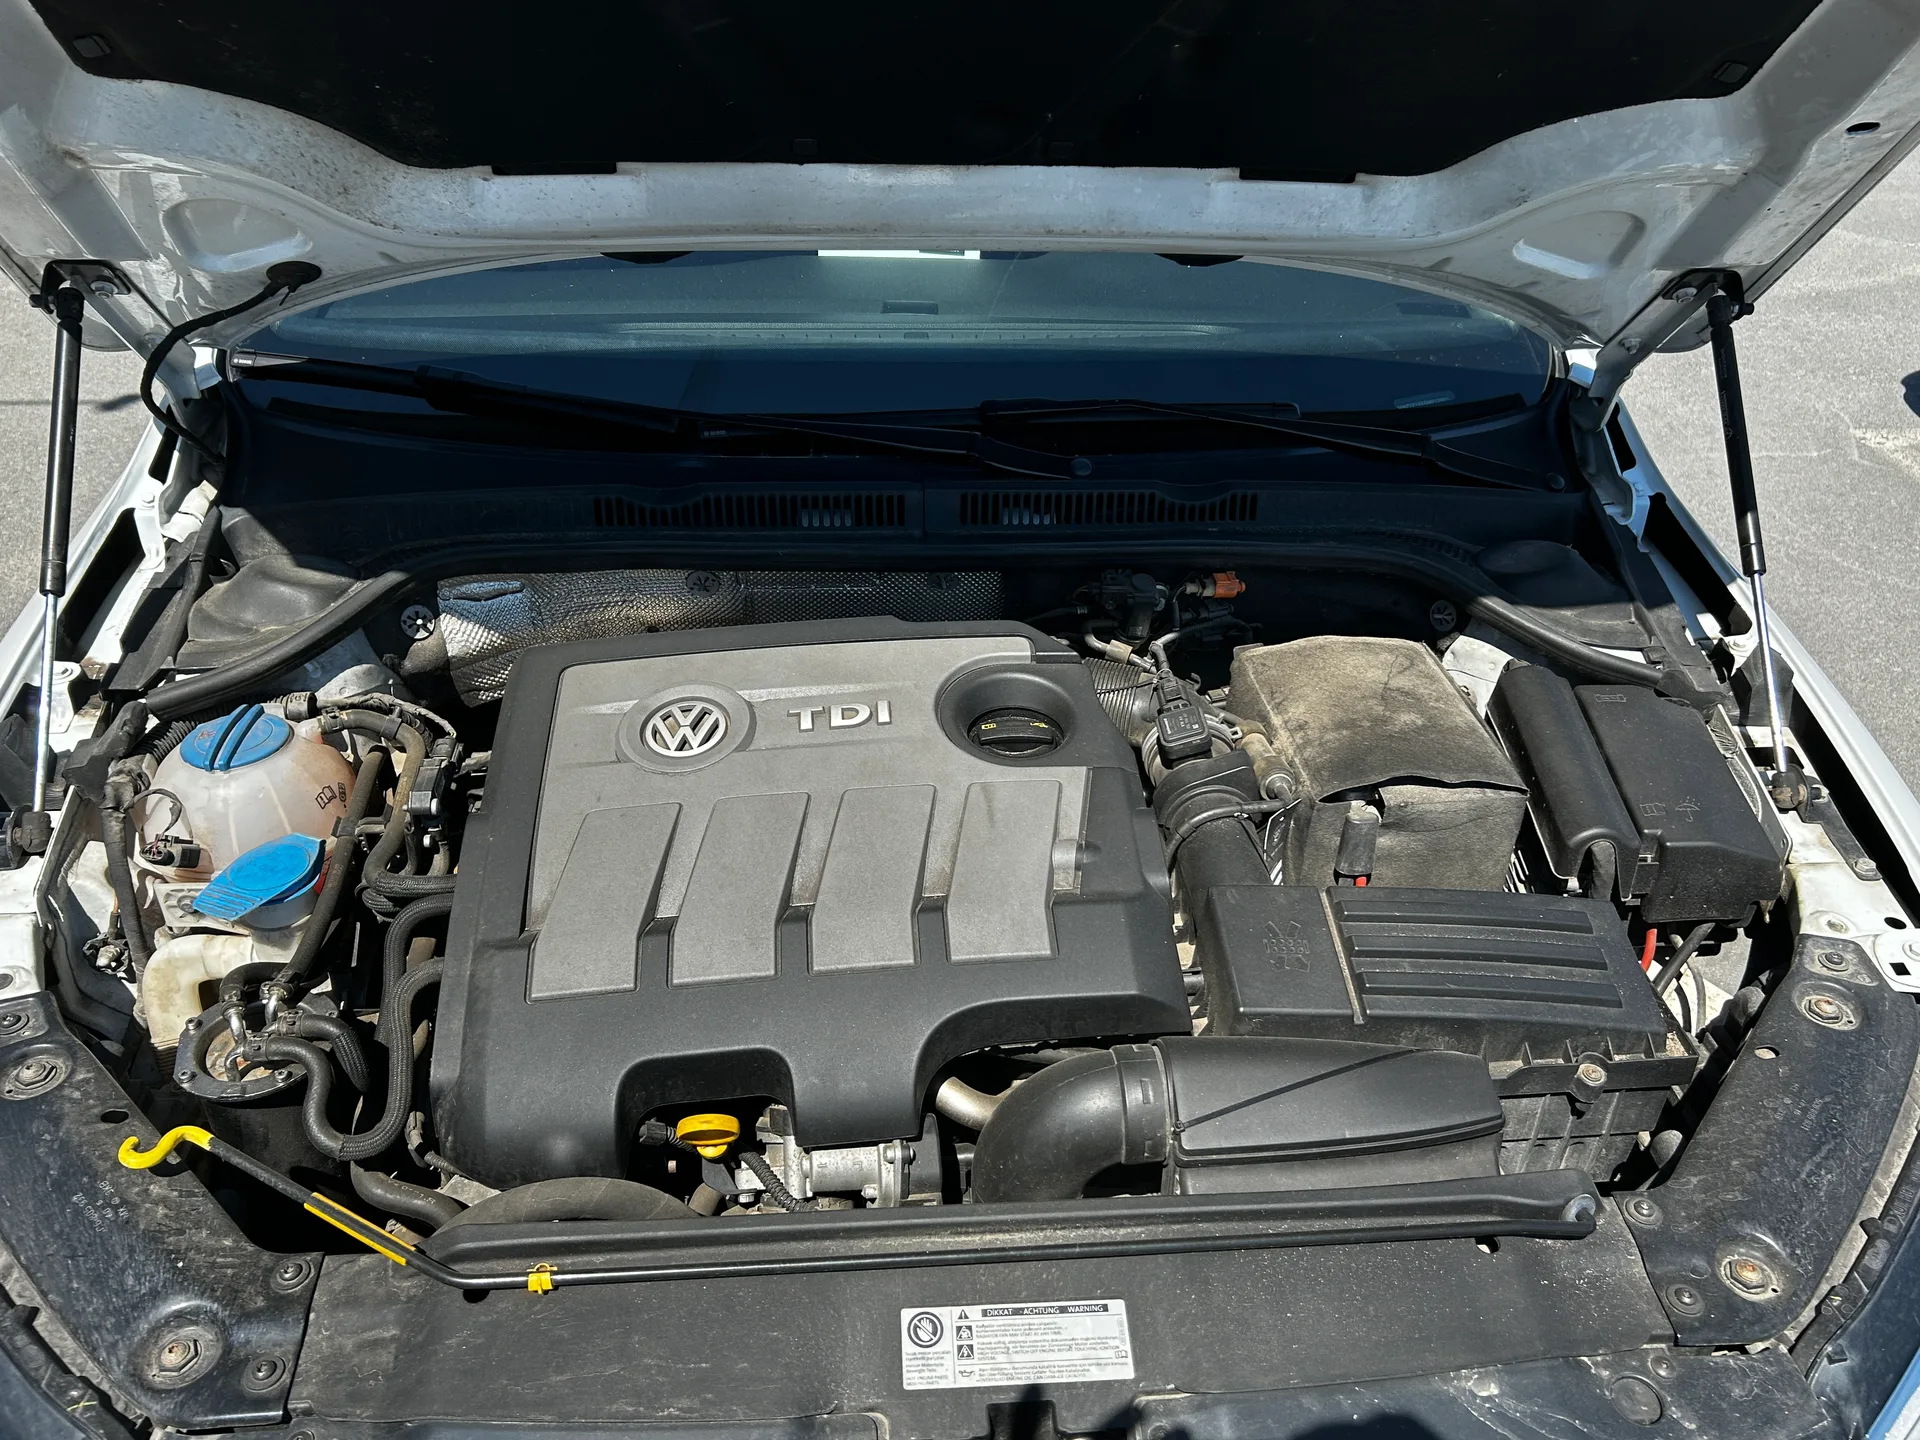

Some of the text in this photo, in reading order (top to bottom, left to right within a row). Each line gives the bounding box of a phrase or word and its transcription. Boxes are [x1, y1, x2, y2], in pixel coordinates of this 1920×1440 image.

[787, 700, 892, 733] TDI
[1022, 1306, 1059, 1314] ACHTUNG
[1067, 1304, 1103, 1312] WARNING
